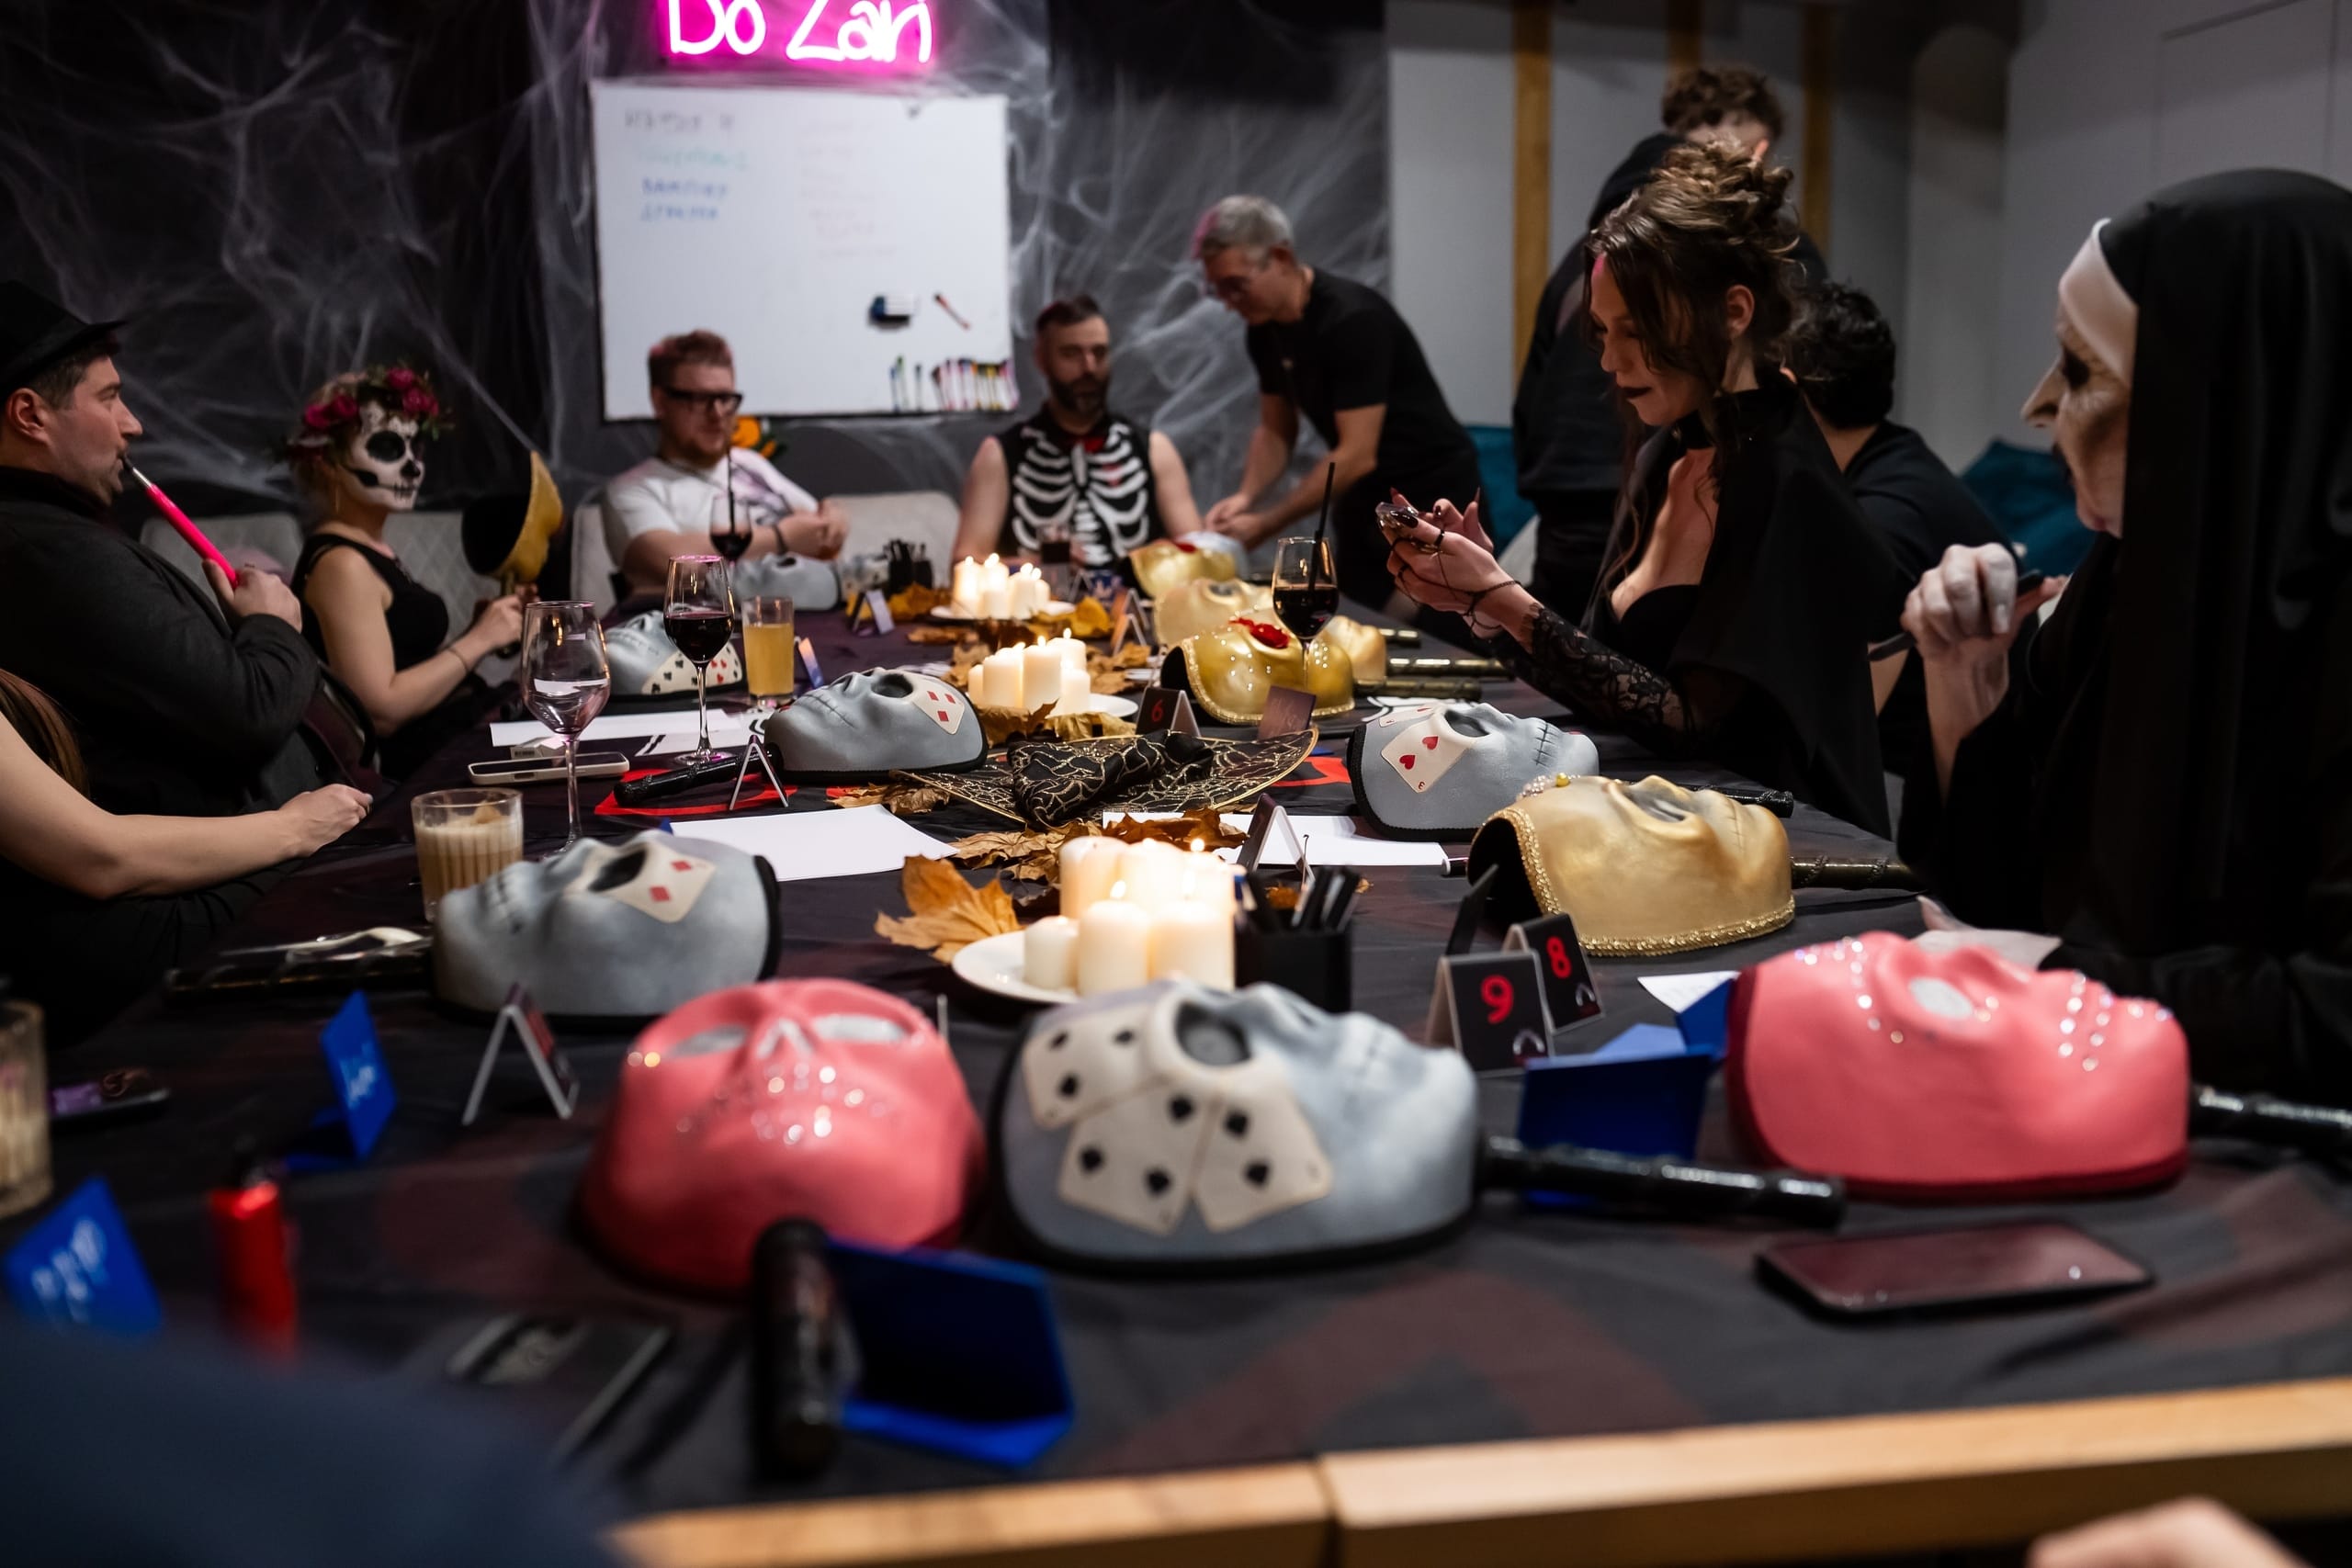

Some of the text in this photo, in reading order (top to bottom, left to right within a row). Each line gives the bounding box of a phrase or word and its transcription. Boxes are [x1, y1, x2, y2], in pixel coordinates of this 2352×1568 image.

[669, 0, 766, 54] Do
[1151, 699, 1164, 722] 6
[1546, 936, 1572, 979] 8
[1480, 975, 1514, 1024] 9
